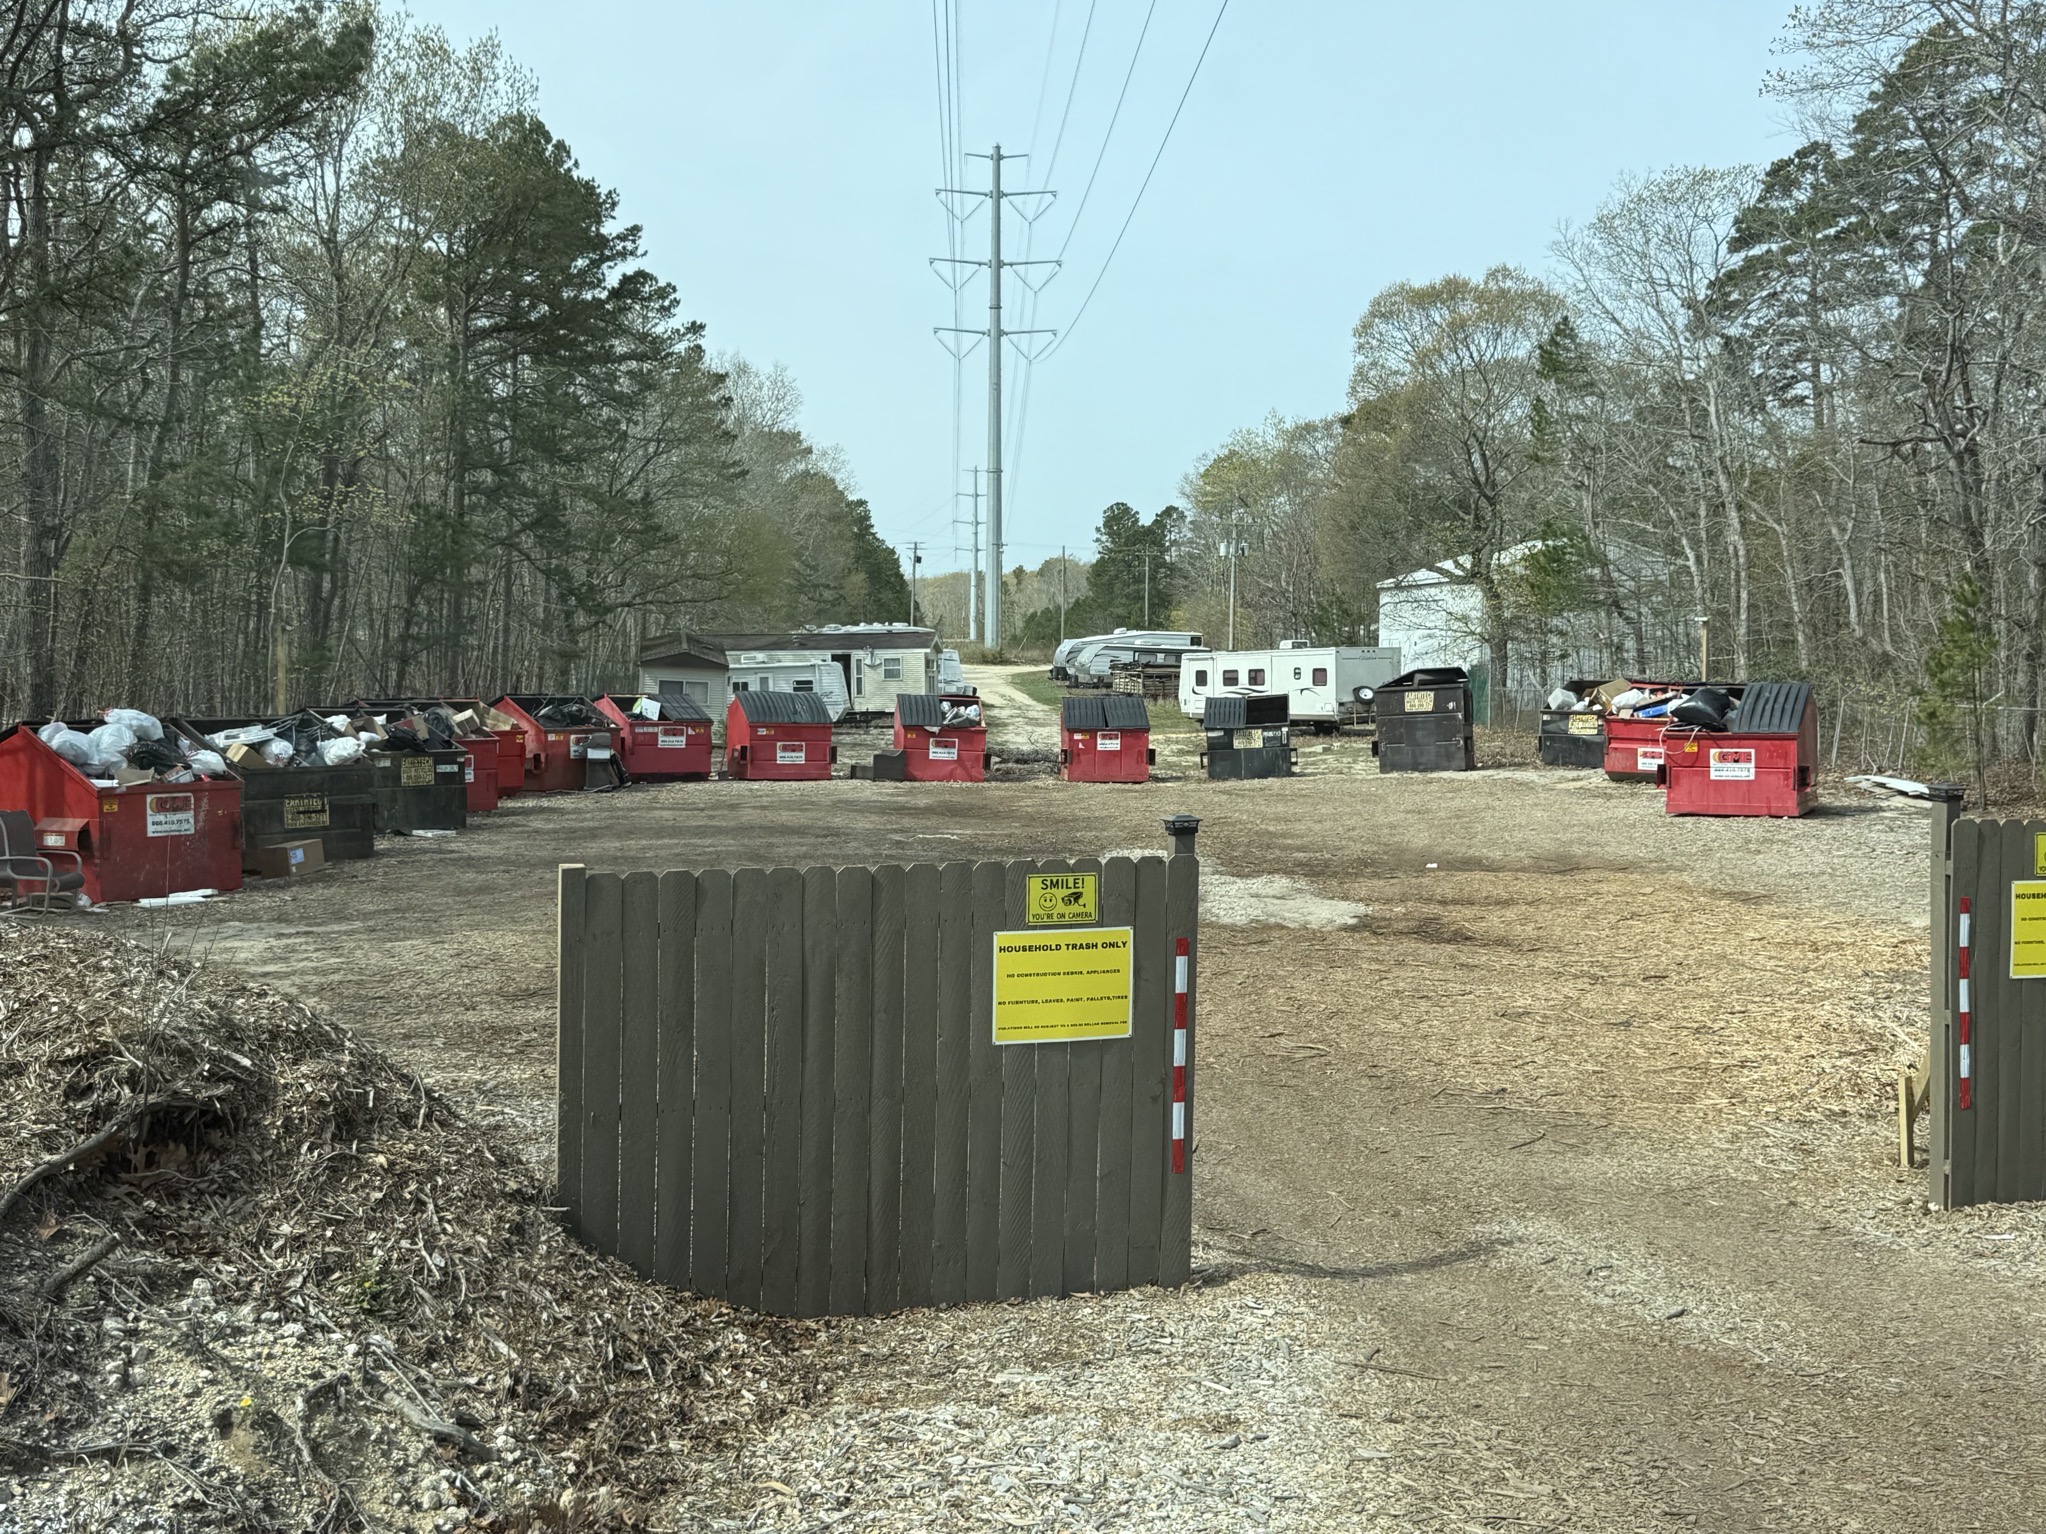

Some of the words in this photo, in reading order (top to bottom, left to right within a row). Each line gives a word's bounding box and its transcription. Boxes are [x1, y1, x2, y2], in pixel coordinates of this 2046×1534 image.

[1041, 878, 1085, 890] SMILE!
[1056, 912, 1066, 920] ON
[1068, 911, 1093, 919] CAMERA
[999, 943, 1062, 953] HOUSEHOLD
[1065, 942, 1098, 950] TRASH
[1101, 940, 1128, 949] ONLY
